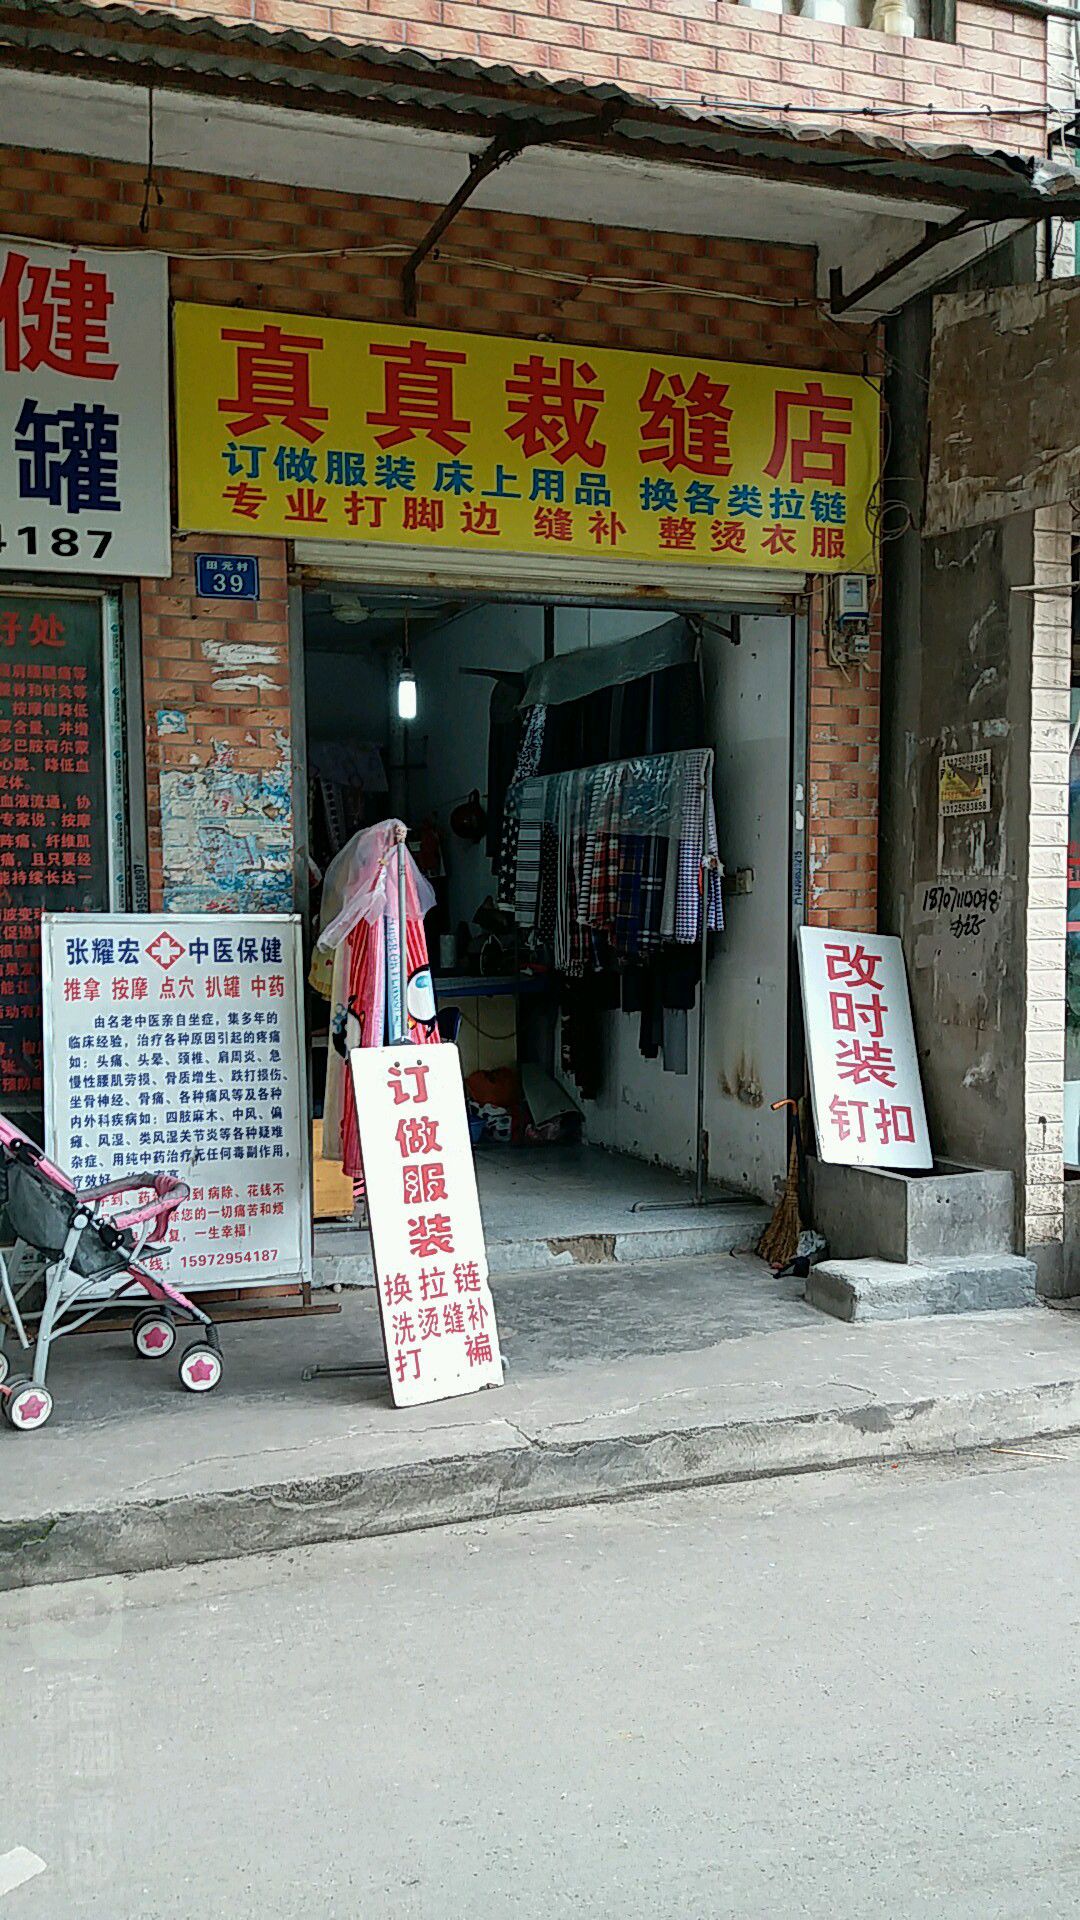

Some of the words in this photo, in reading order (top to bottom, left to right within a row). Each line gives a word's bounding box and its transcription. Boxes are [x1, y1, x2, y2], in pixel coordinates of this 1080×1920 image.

[0, 252, 119, 380] 健
[218, 323, 853, 488] 真真裁缝店
[15, 398, 121, 514] 罐
[222, 441, 416, 491] 订做服装
[433, 460, 611, 507] 床上用品
[639, 477, 847, 524] 换各类拉链
[0, 526, 113, 559] 187
[222, 482, 500, 536] 专业打脚边
[533, 506, 626, 545] 缝补
[659, 517, 846, 559] 整烫衣服
[206, 560, 248, 572] 田元村
[213, 573, 243, 593] 39
[66, 937, 140, 965] 张耀宏
[189, 935, 283, 964] 中医保健
[64, 977, 101, 1002] 推拿
[112, 976, 149, 1000] 按摩
[159, 976, 195, 999] 点穴
[205, 975, 240, 999] 扒罐
[251, 974, 285, 999] 中药
[823, 943, 898, 1089] 改时装
[828, 1095, 915, 1144] 钉扣
[387, 1065, 455, 1258] 订做服装
[384, 1260, 482, 1307] 换拉链
[392, 1297, 489, 1346] 洗烫缝补
[395, 1348, 423, 1383] 打
